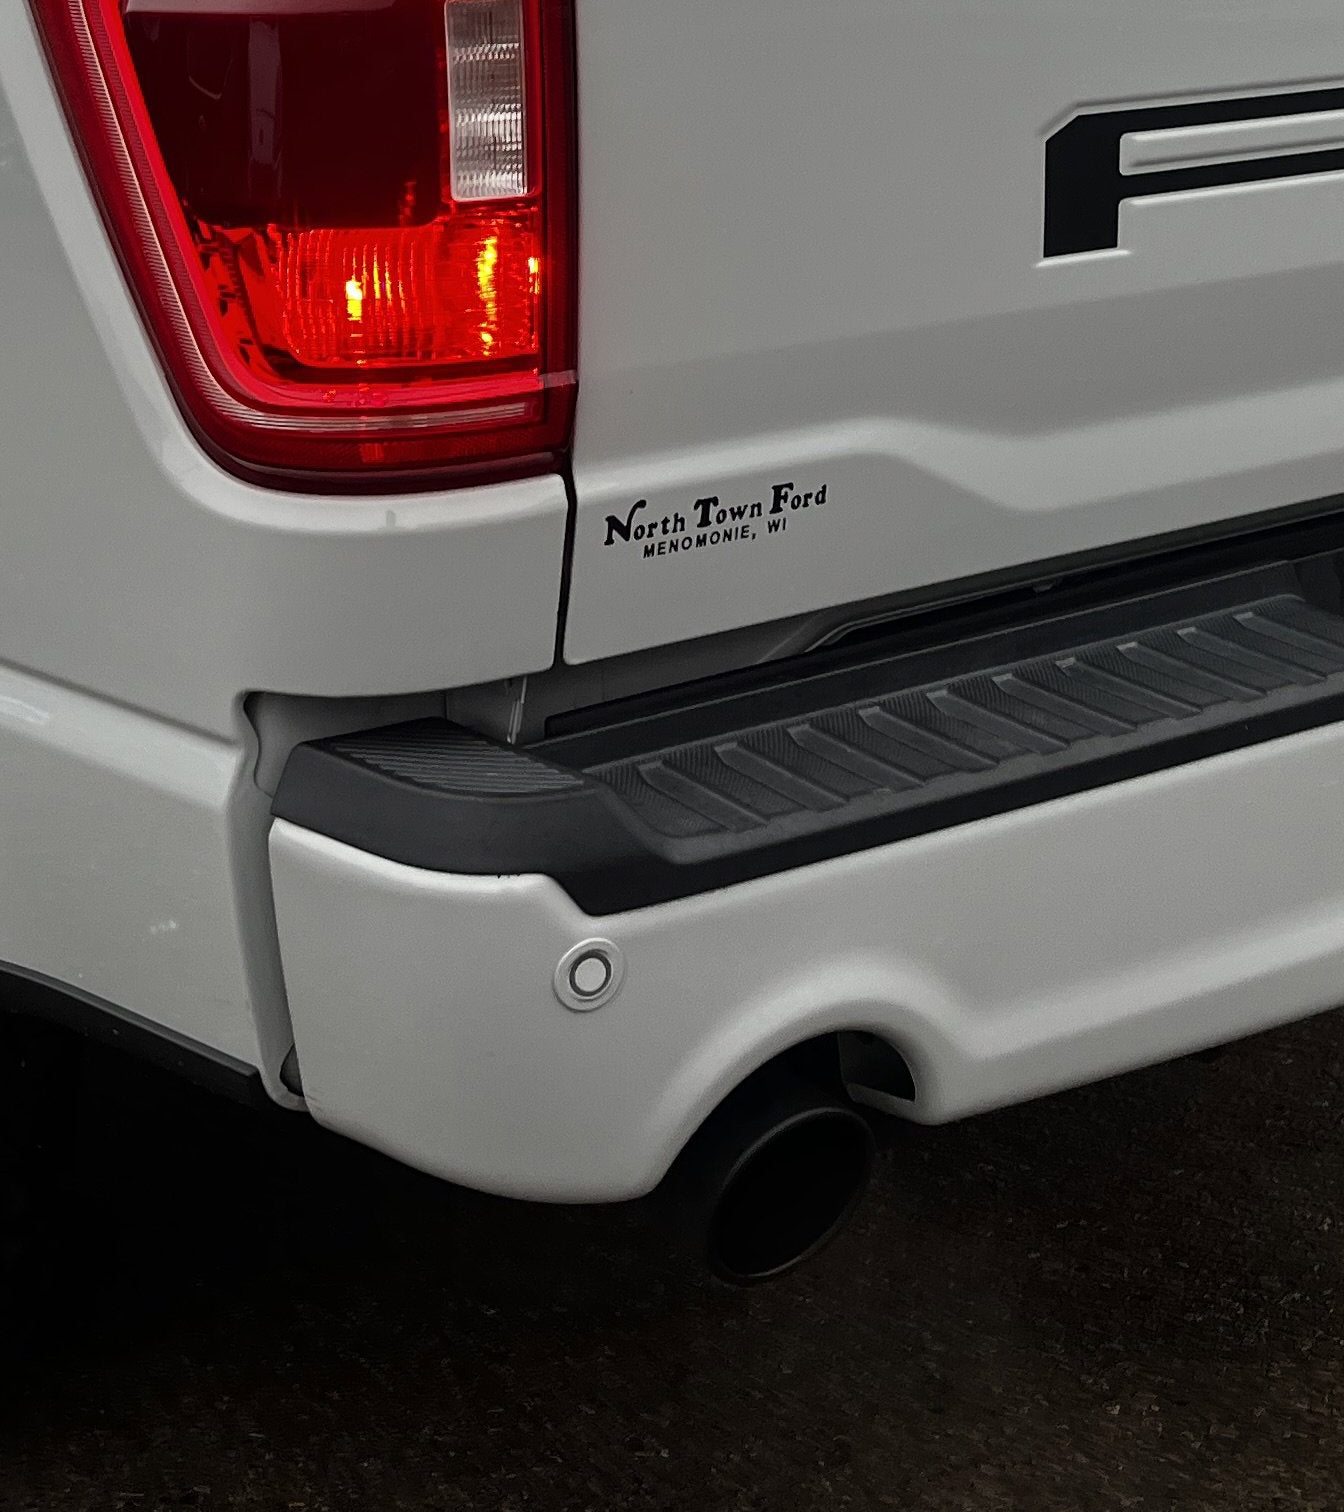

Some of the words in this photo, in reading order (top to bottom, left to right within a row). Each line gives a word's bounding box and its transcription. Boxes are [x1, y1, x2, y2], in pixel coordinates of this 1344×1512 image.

[604, 499, 686, 546] North
[693, 496, 763, 529] Town
[769, 482, 828, 515] Ford
[642, 525, 757, 559] MENOMONIE,
[767, 517, 787, 535] WI
